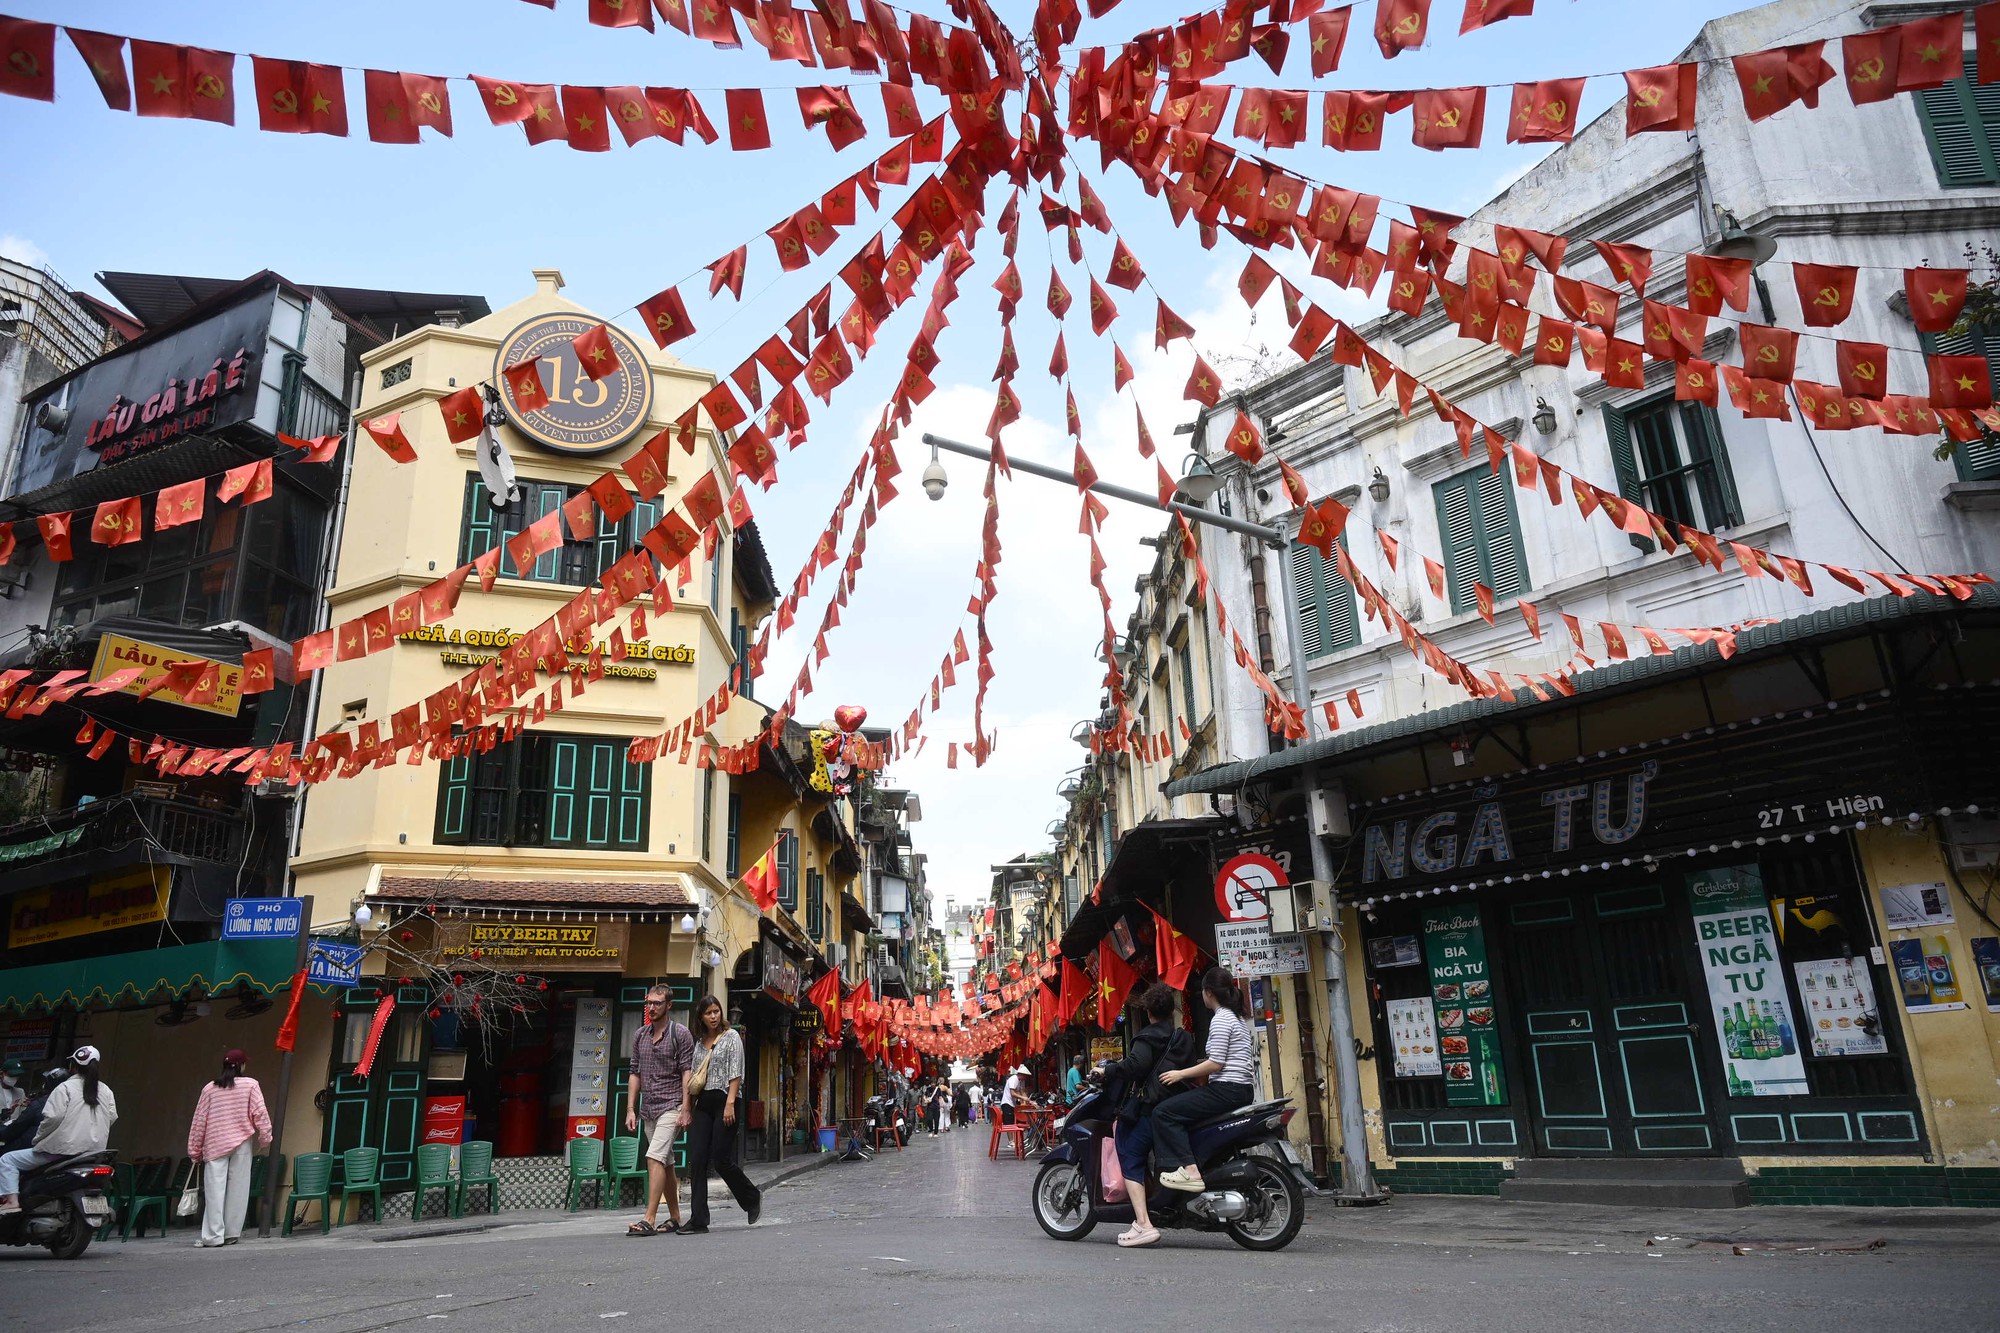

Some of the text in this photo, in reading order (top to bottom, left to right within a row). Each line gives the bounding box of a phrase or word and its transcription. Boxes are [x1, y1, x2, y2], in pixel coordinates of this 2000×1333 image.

[527, 332, 538, 343] OF
[538, 326, 556, 337] THE
[557, 322, 585, 332] HUY
[617, 345, 637, 366] TAY
[541, 355, 609, 408] 15
[632, 372, 642, 388] TA
[85, 347, 245, 447] LẨU GÀ LÁ É
[626, 389, 643, 417] HIEN
[571, 432, 599, 443] DUC
[600, 420, 626, 439] HUY
[449, 628, 461, 644] 4
[113, 643, 158, 667] LẨU
[441, 651, 469, 664] THE
[652, 643, 696, 663] GIỚI
[225, 672, 239, 687] É
[1361, 759, 1658, 884] NGÃ TƯ
[1757, 807, 1784, 829] 27
[1692, 879, 1740, 898] Carlsberg
[257, 901, 283, 912] PHỐ
[253, 918, 273, 935] NGỌC
[274, 913, 298, 932] QUYẾN
[1425, 919, 1450, 934] Trúc
[1699, 915, 1772, 941] BEER
[475, 927, 593, 942] HUY BEER TAY
[574, 946, 604, 957] QUỐC
[606, 947, 619, 957] TẾ
[1443, 946, 1468, 959] BIA
[1708, 938, 1774, 968] NGÃ
[310, 961, 324, 978] TẠ
[1433, 960, 1483, 978] NGÃ TƯ
[1724, 968, 1766, 994] TƯ
[794, 1020, 812, 1028] BAR
[580, 1049, 594, 1058] Tiger
[577, 1073, 591, 1081] Tiger
[575, 1096, 590, 1105] Tiger
